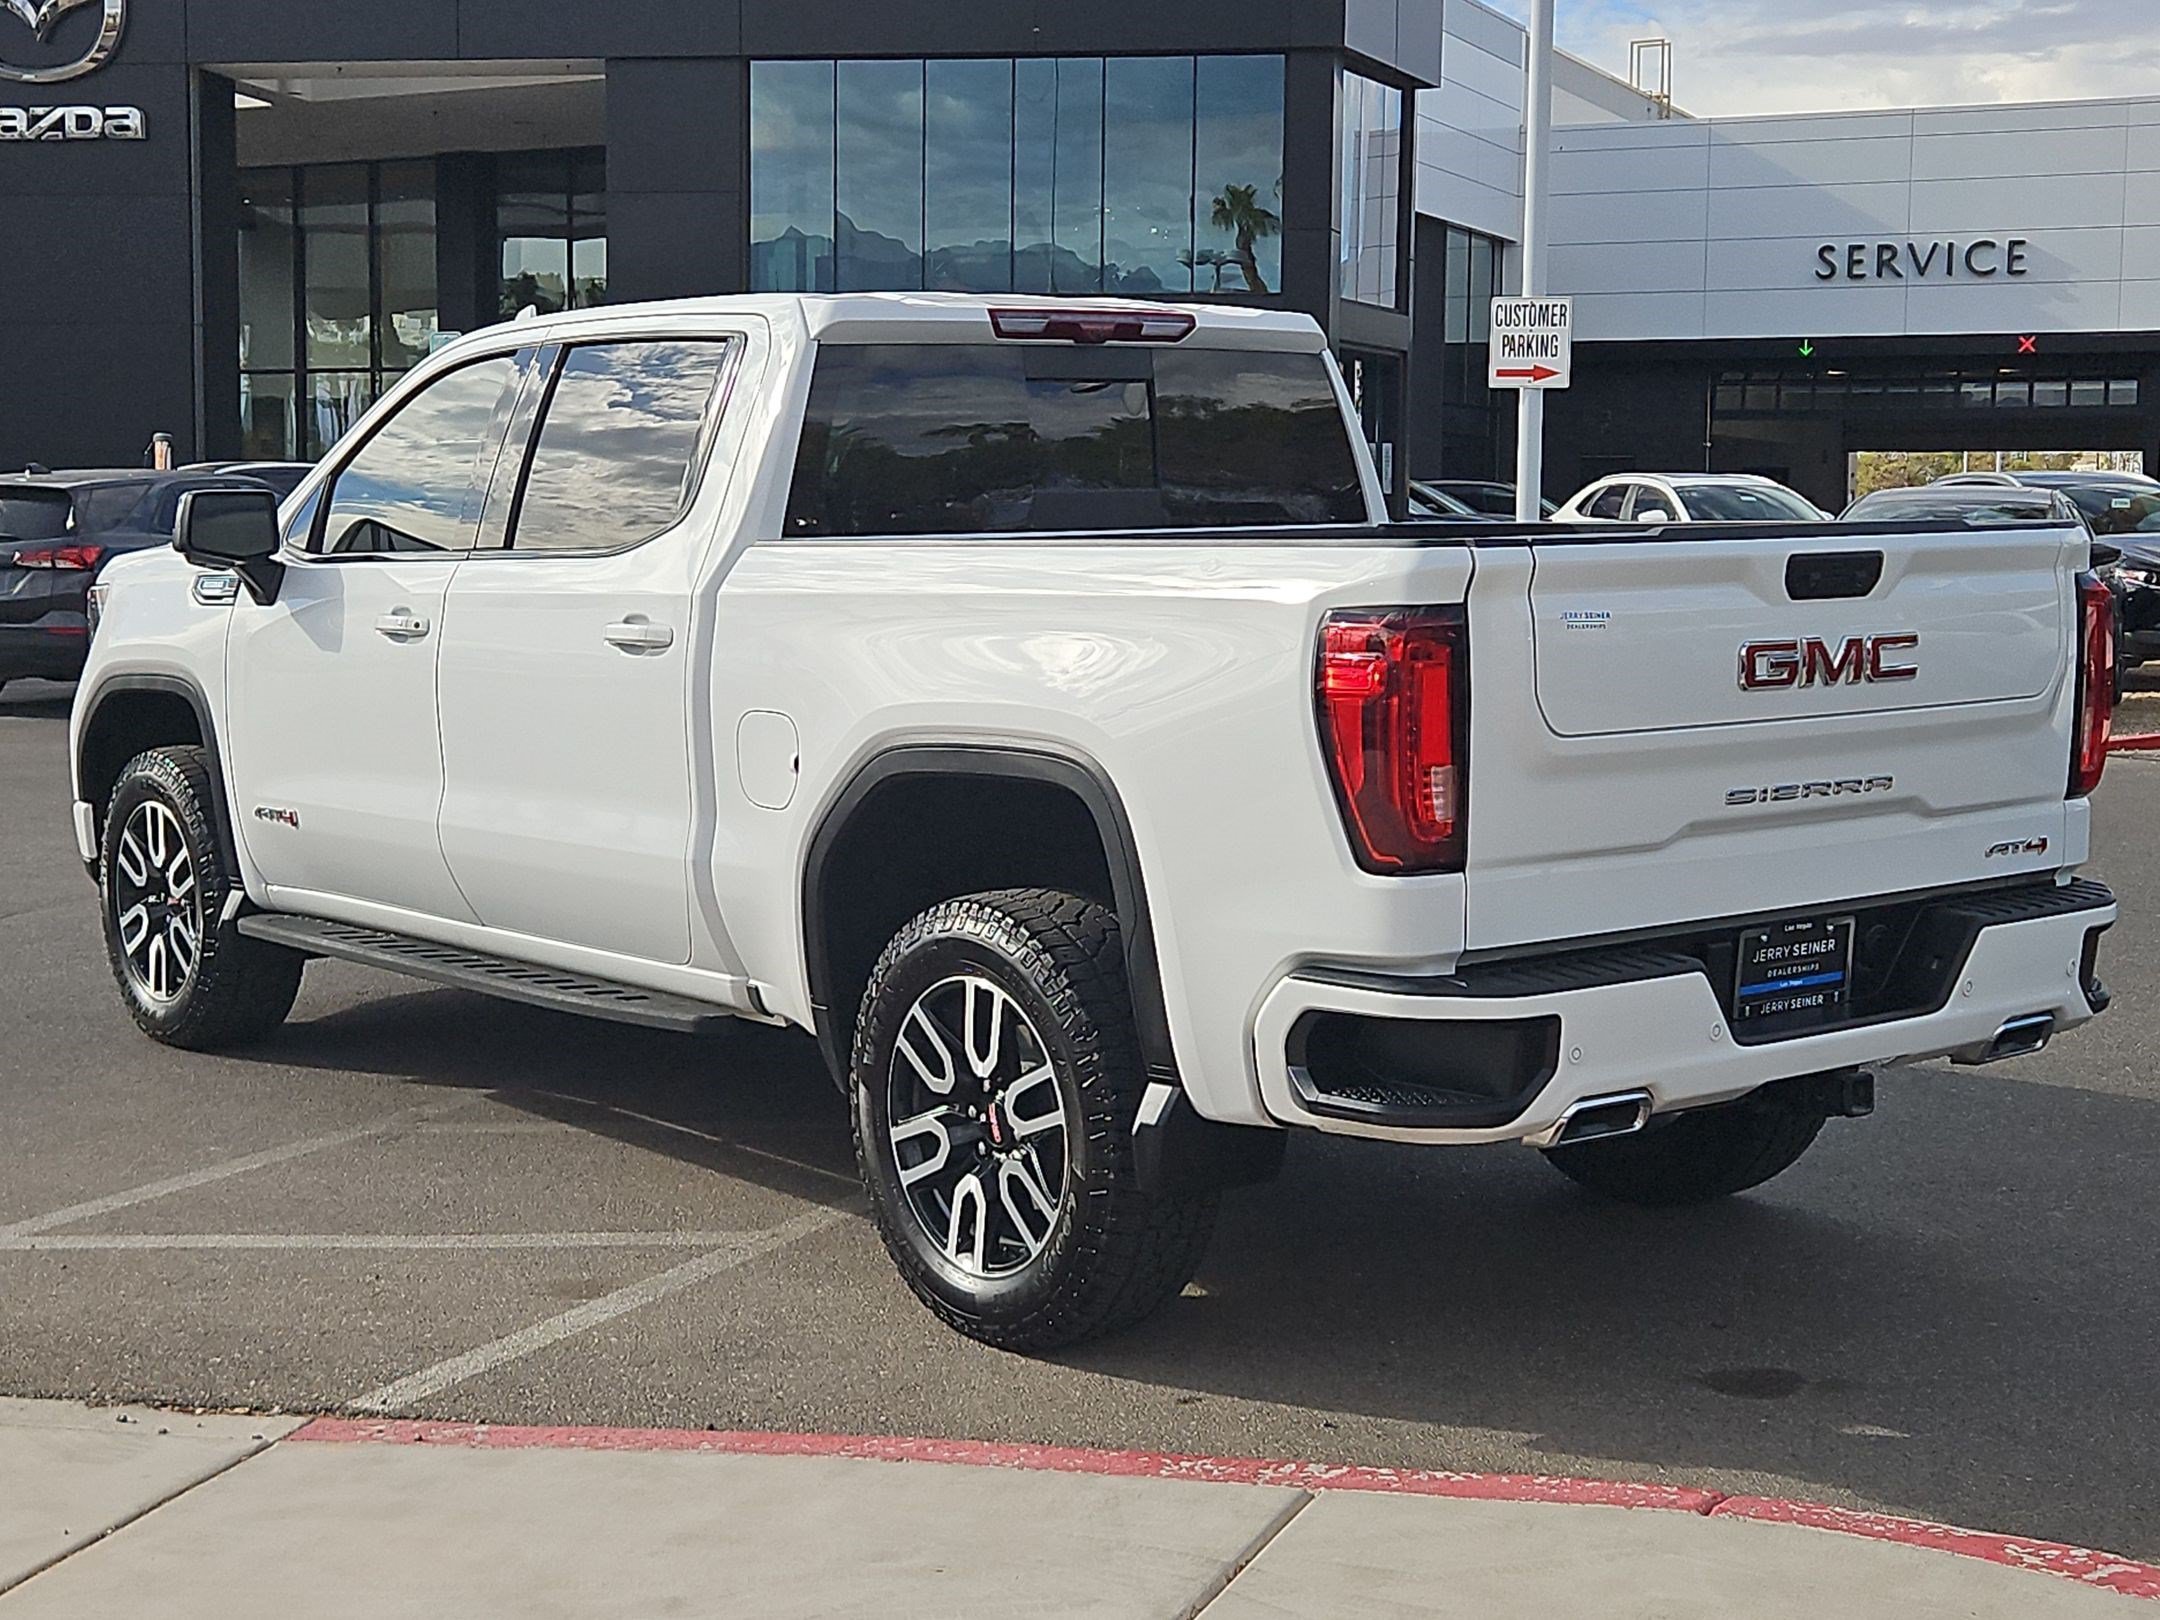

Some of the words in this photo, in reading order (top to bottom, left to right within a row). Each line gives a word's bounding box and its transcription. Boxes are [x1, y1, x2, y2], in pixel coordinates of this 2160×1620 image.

[1815, 239, 2028, 280] SERVICE
[1495, 303, 1568, 327] CUSTOMER
[1501, 334, 1559, 358] PARKING
[1738, 630, 1920, 691] GMC
[1725, 776, 1894, 805] SIERRA
[1985, 835, 2048, 858] AT4
[1752, 944, 1791, 963] JERRY
[1792, 939, 1836, 957] SEINER
[1767, 962, 1820, 978] DEALERSHIPS
[1760, 1000, 1789, 1015] JERRY
[1790, 994, 1824, 1010] SEINER
